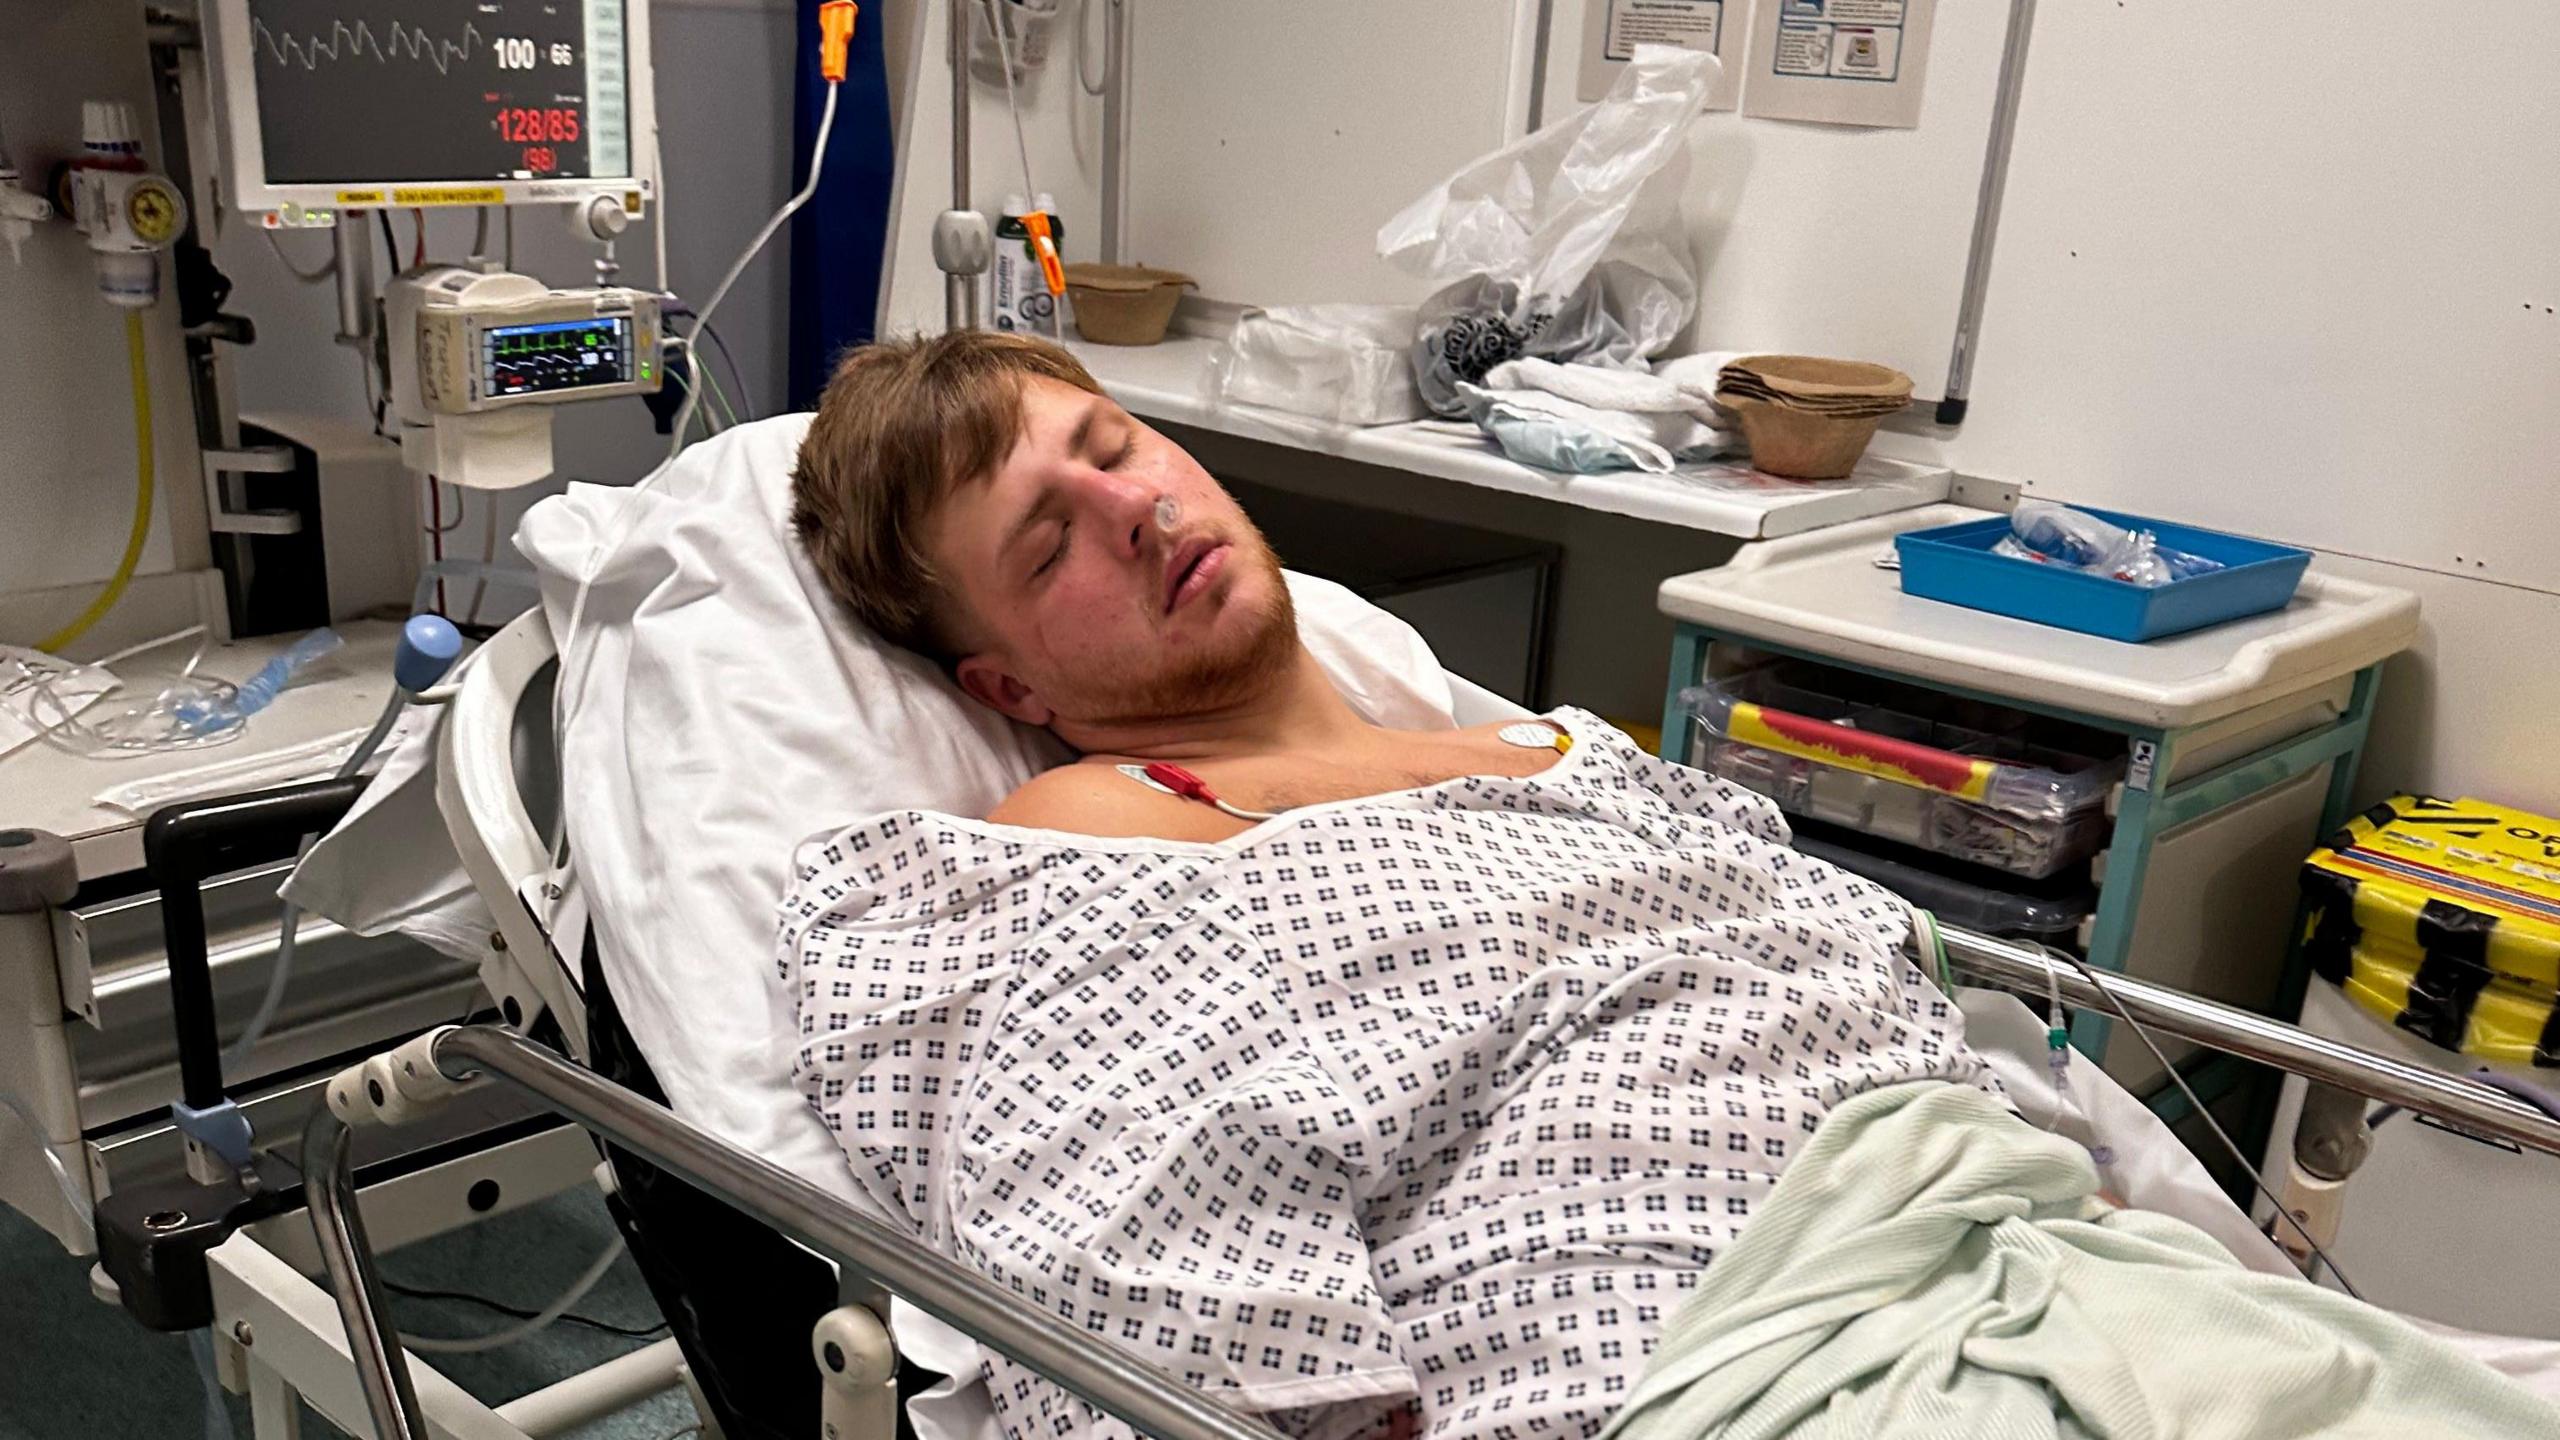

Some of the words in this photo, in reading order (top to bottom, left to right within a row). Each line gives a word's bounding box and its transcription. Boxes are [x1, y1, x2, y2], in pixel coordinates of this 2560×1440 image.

[494, 39, 535, 69] 100
[551, 43, 572, 65] 66
[498, 109, 579, 142] 128/85
